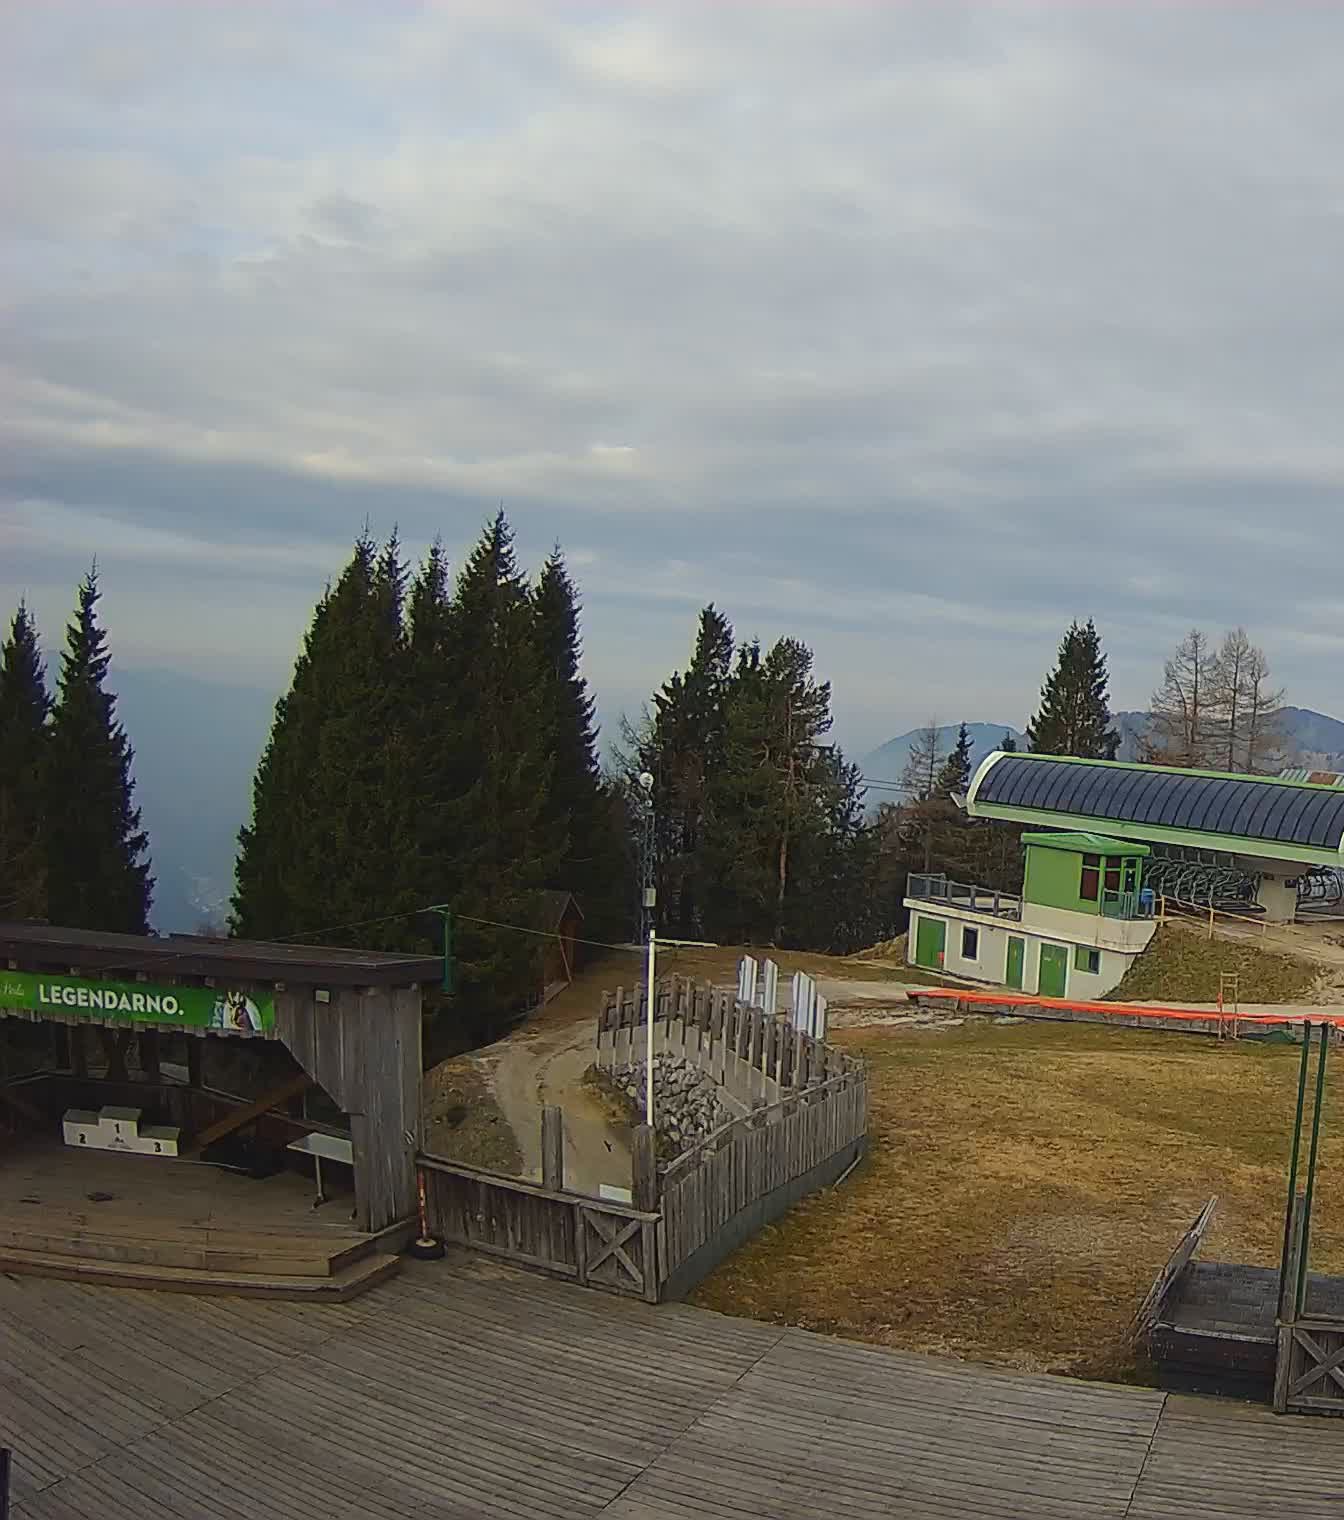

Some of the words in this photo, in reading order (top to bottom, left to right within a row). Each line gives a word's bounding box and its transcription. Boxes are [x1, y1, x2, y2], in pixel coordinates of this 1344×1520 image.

[39, 983, 185, 1016] LEGENDARNO.
[114, 1122, 121, 1134] 1
[79, 1133, 86, 1144] 2
[153, 1141, 162, 1153] 3
